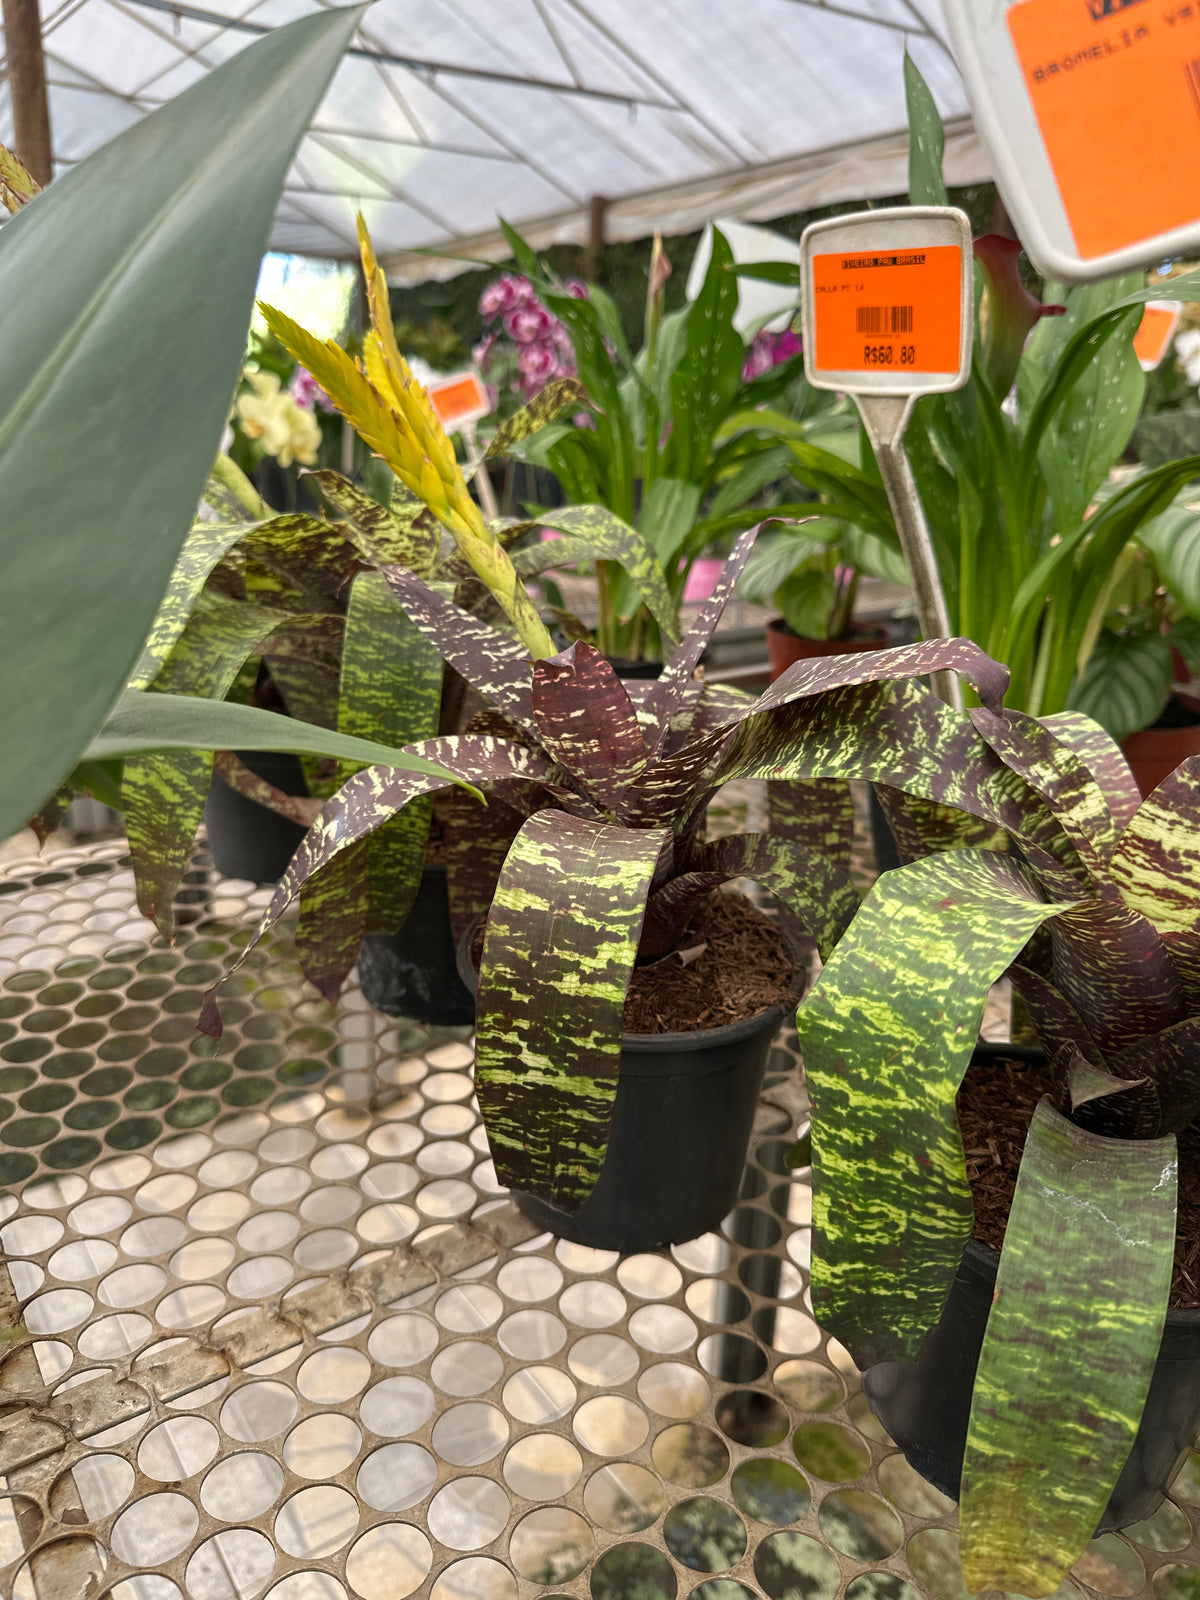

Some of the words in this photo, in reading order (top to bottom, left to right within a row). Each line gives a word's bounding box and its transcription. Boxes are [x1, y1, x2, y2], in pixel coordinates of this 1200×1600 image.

[1032, 26, 1149, 83] BROMELIA
[896, 255, 925, 265] BRASIL
[864, 345, 915, 365] R$60.80
